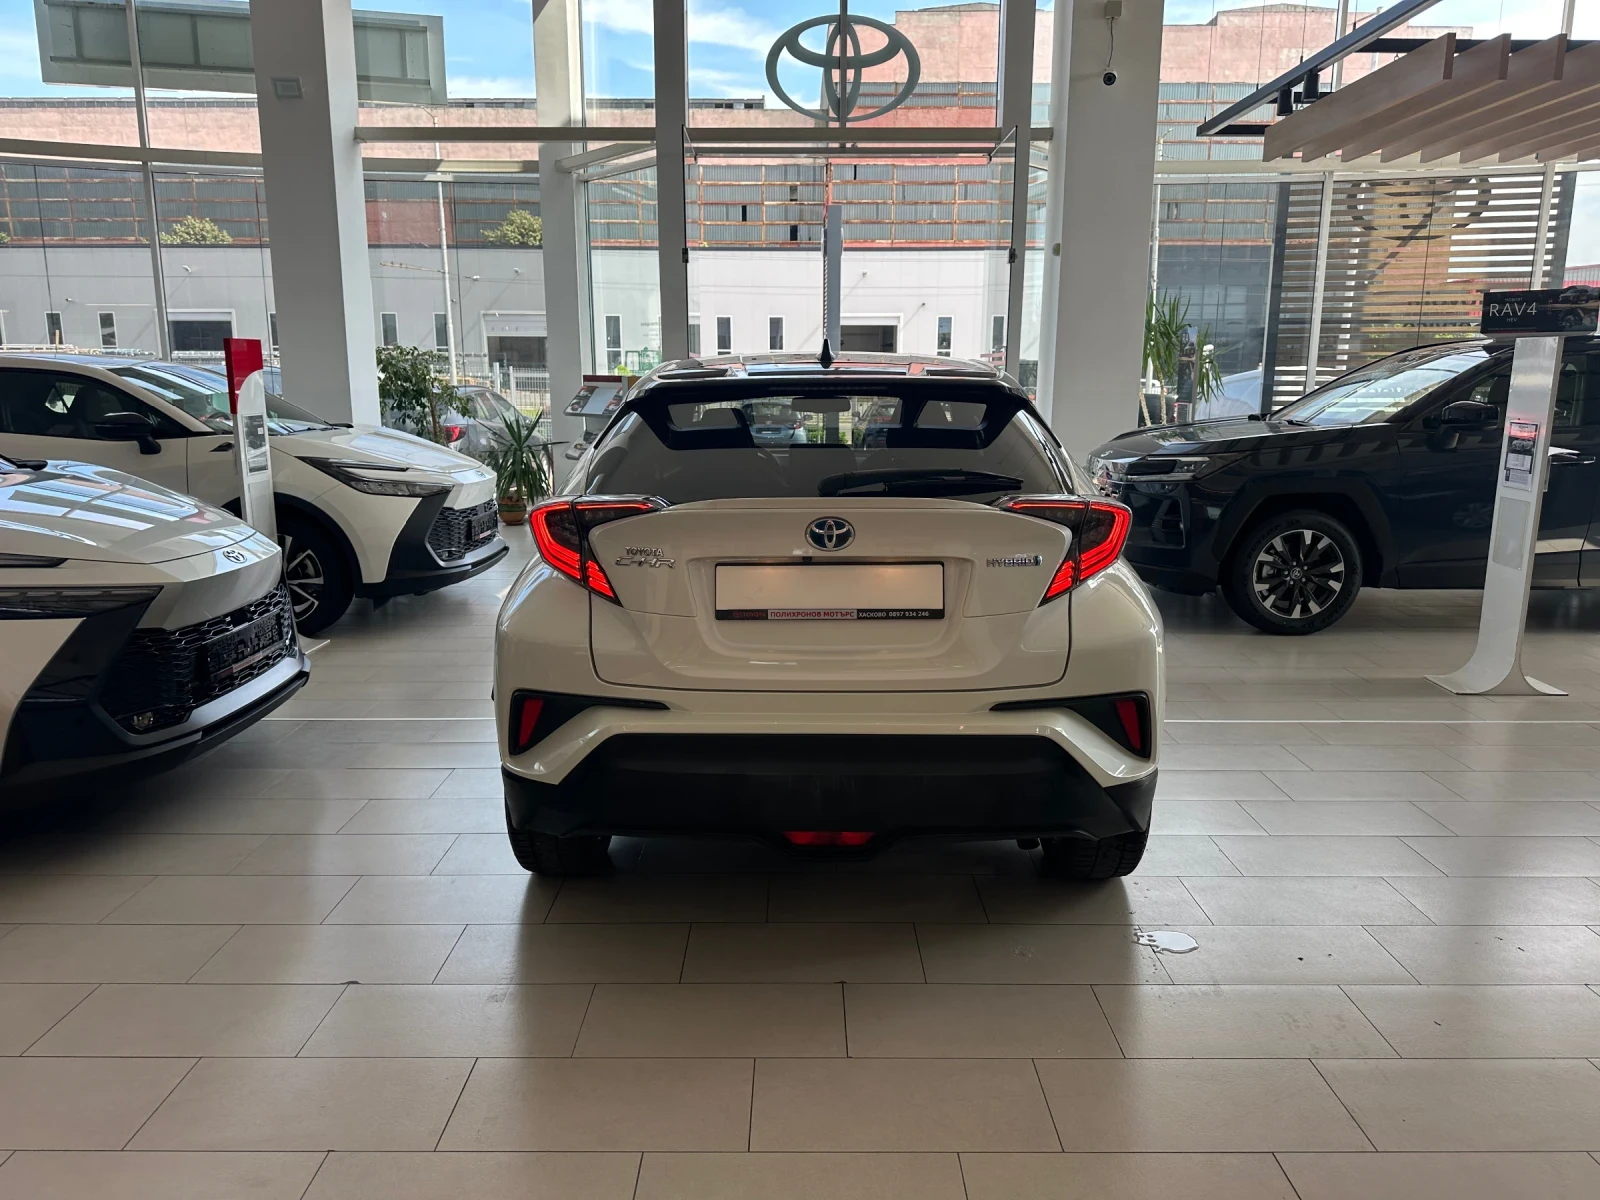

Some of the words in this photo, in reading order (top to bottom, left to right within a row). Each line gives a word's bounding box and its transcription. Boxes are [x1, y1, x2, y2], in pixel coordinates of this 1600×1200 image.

[1489, 302, 1537, 316] RAV4
[625, 546, 664, 557] TOYOTA
[615, 557, 675, 569] C-HR
[986, 557, 1034, 568] HYBRID
